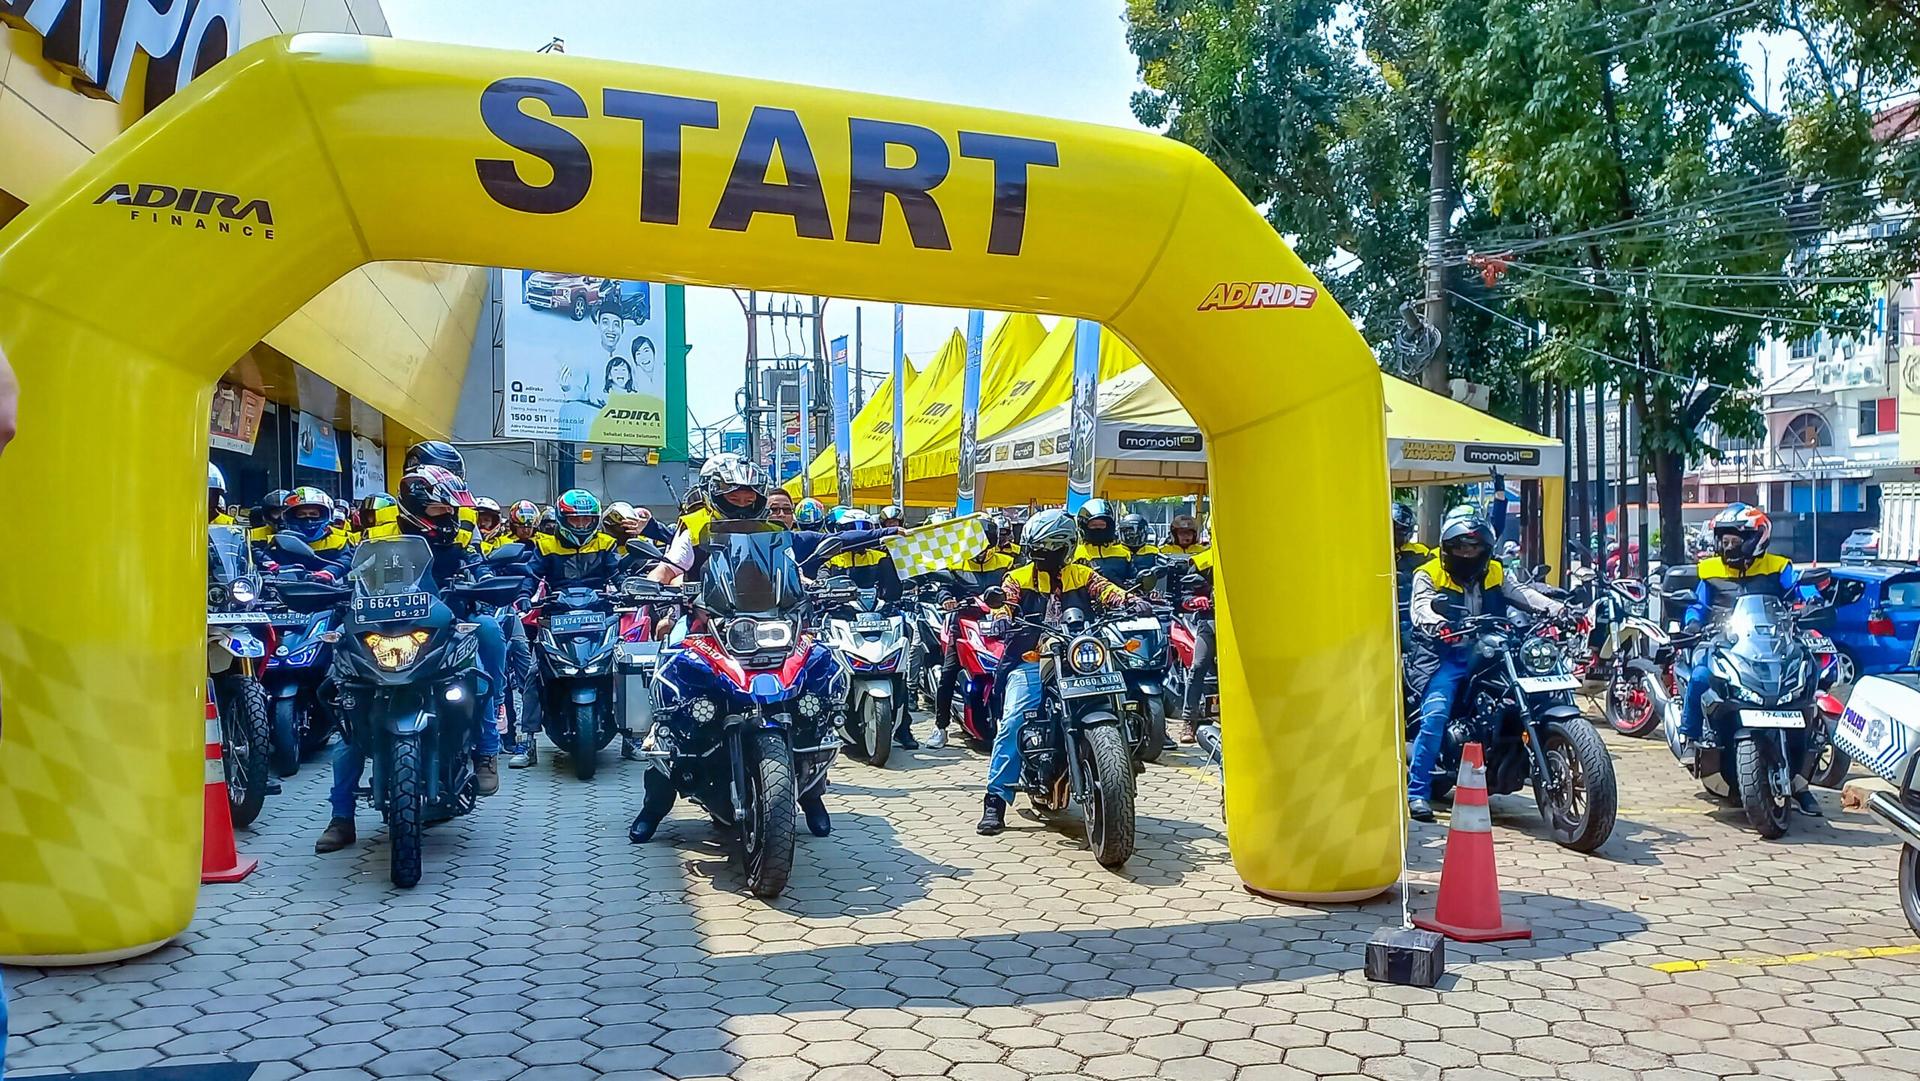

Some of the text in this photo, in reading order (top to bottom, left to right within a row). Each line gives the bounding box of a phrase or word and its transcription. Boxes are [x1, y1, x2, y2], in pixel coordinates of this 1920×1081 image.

[474, 77, 1059, 257] START
[93, 184, 273, 225] ADIRA
[131, 211, 274, 239] FINANCE
[1198, 282, 1317, 310] ADIRIDE
[510, 413, 532, 421] 1500
[534, 414, 547, 422] 511
[604, 409, 660, 421] ADIRA
[1126, 436, 1181, 447] momobil
[1470, 451, 1519, 461] momobil
[357, 594, 426, 610] B 6645 JCH
[1843, 706, 1867, 732] POLISI
